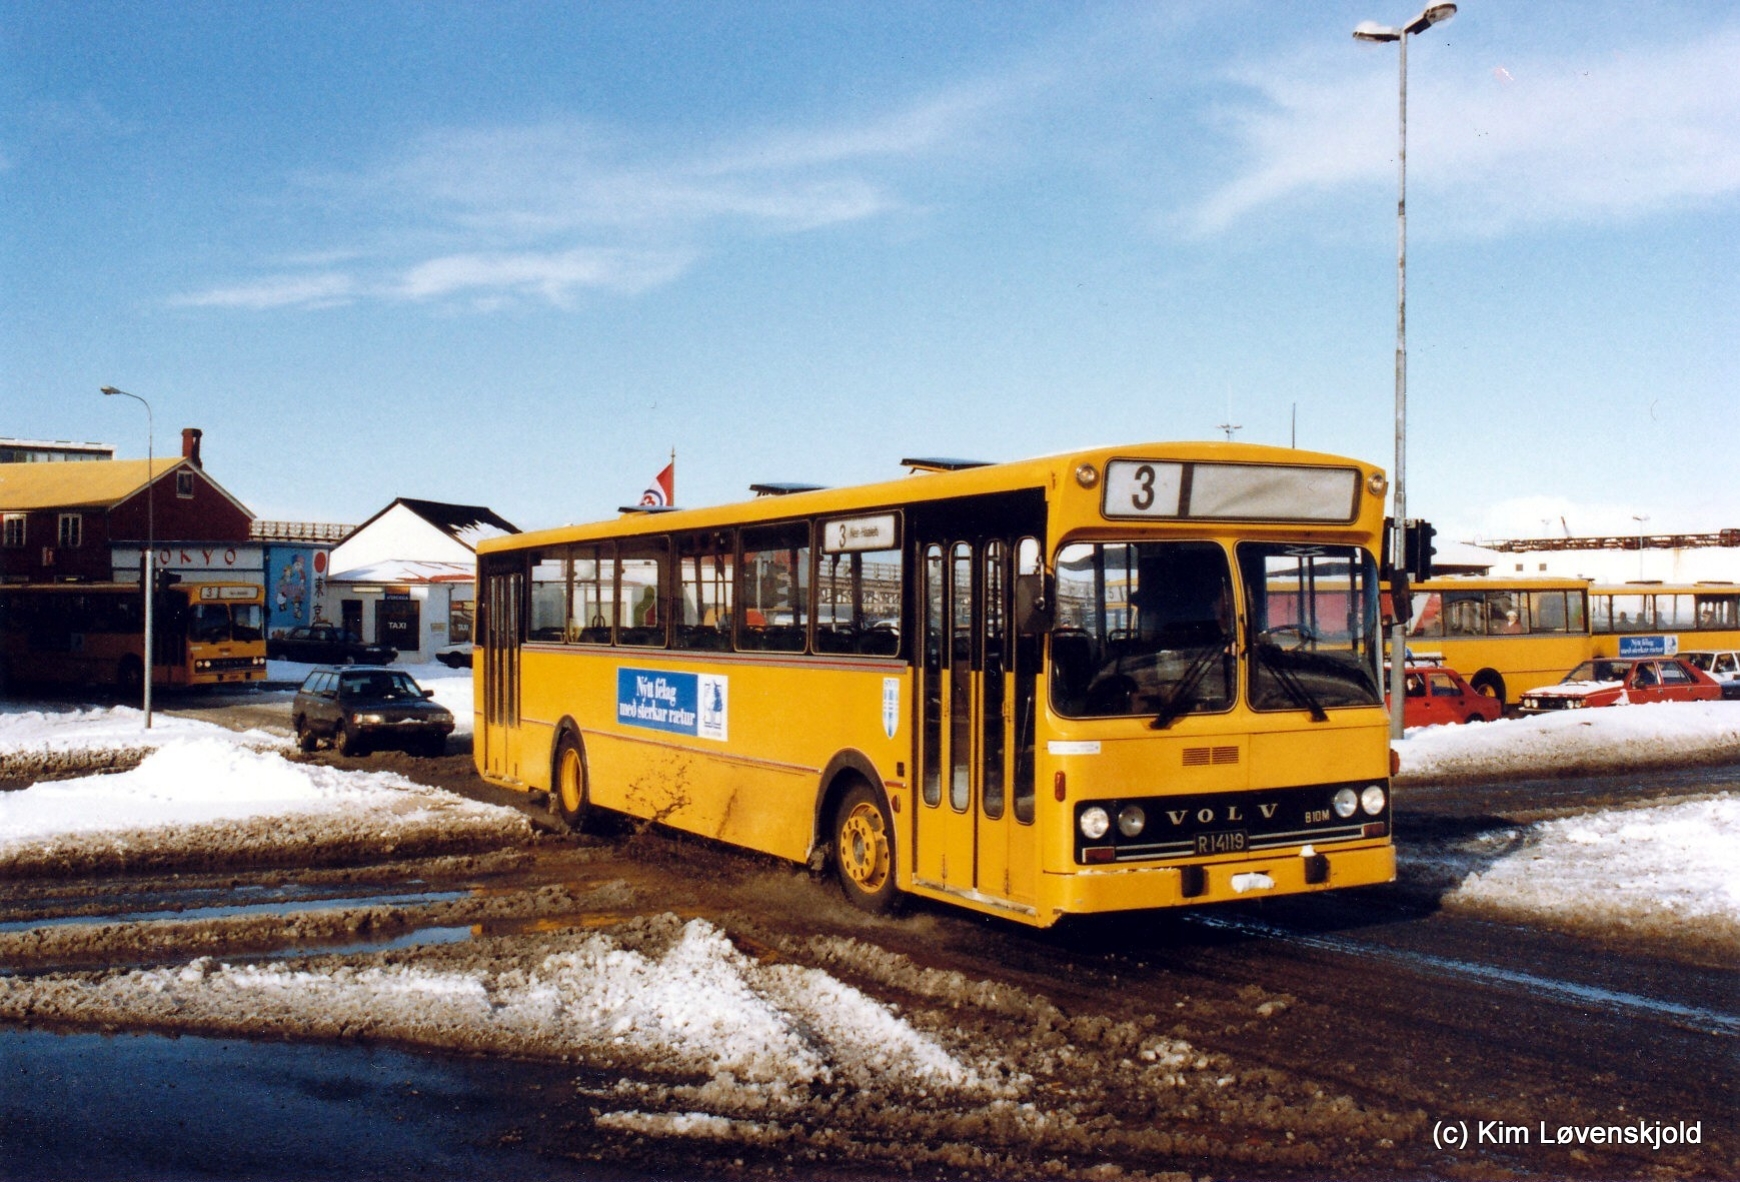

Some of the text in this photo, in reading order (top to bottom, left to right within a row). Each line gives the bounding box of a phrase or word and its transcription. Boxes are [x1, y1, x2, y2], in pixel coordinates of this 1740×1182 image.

[1131, 465, 1156, 511] 3
[839, 523, 846, 548] 3
[141, 548, 236, 566] OKYO
[206, 588, 213, 599] 3
[388, 622, 407, 630] TAXI
[1165, 803, 1279, 826] VOLV
